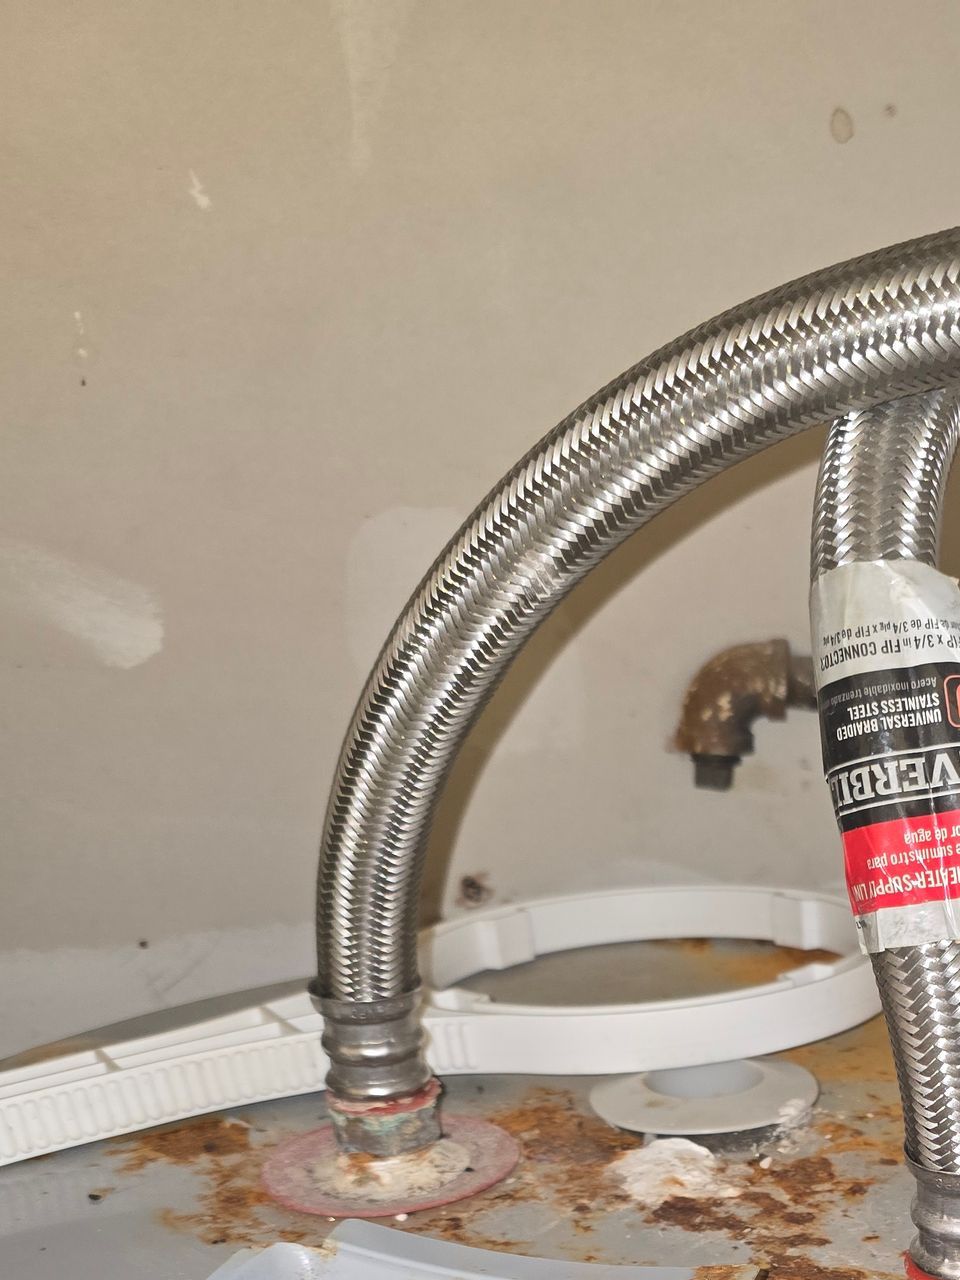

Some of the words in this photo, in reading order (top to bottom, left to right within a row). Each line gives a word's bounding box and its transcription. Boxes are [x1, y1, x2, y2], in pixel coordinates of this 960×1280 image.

[854, 624, 870, 639] FIP
[871, 623, 877, 634] x
[892, 619, 908, 634] 3/4
[909, 617, 922, 631] de
[924, 615, 939, 631] FIP
[830, 630, 841, 647] 3/4
[841, 627, 852, 641] de
[901, 636, 911, 649] in
[913, 632, 934, 650] 3/4
[935, 632, 943, 645] x
[880, 637, 901, 655] FIP
[862, 679, 909, 700] inoxidable
[910, 675, 937, 692] Acero
[829, 687, 862, 708] trenzado
[879, 690, 940, 715] STAINLESS
[846, 700, 879, 720] STEEL
[879, 706, 942, 733] UNIVERSAL
[835, 716, 879, 742] BRAIDED
[902, 825, 932, 848] agua
[933, 826, 948, 843] de
[865, 850, 888, 872] para
[889, 842, 953, 868] suministro
[868, 871, 911, 897] SUPPLY
